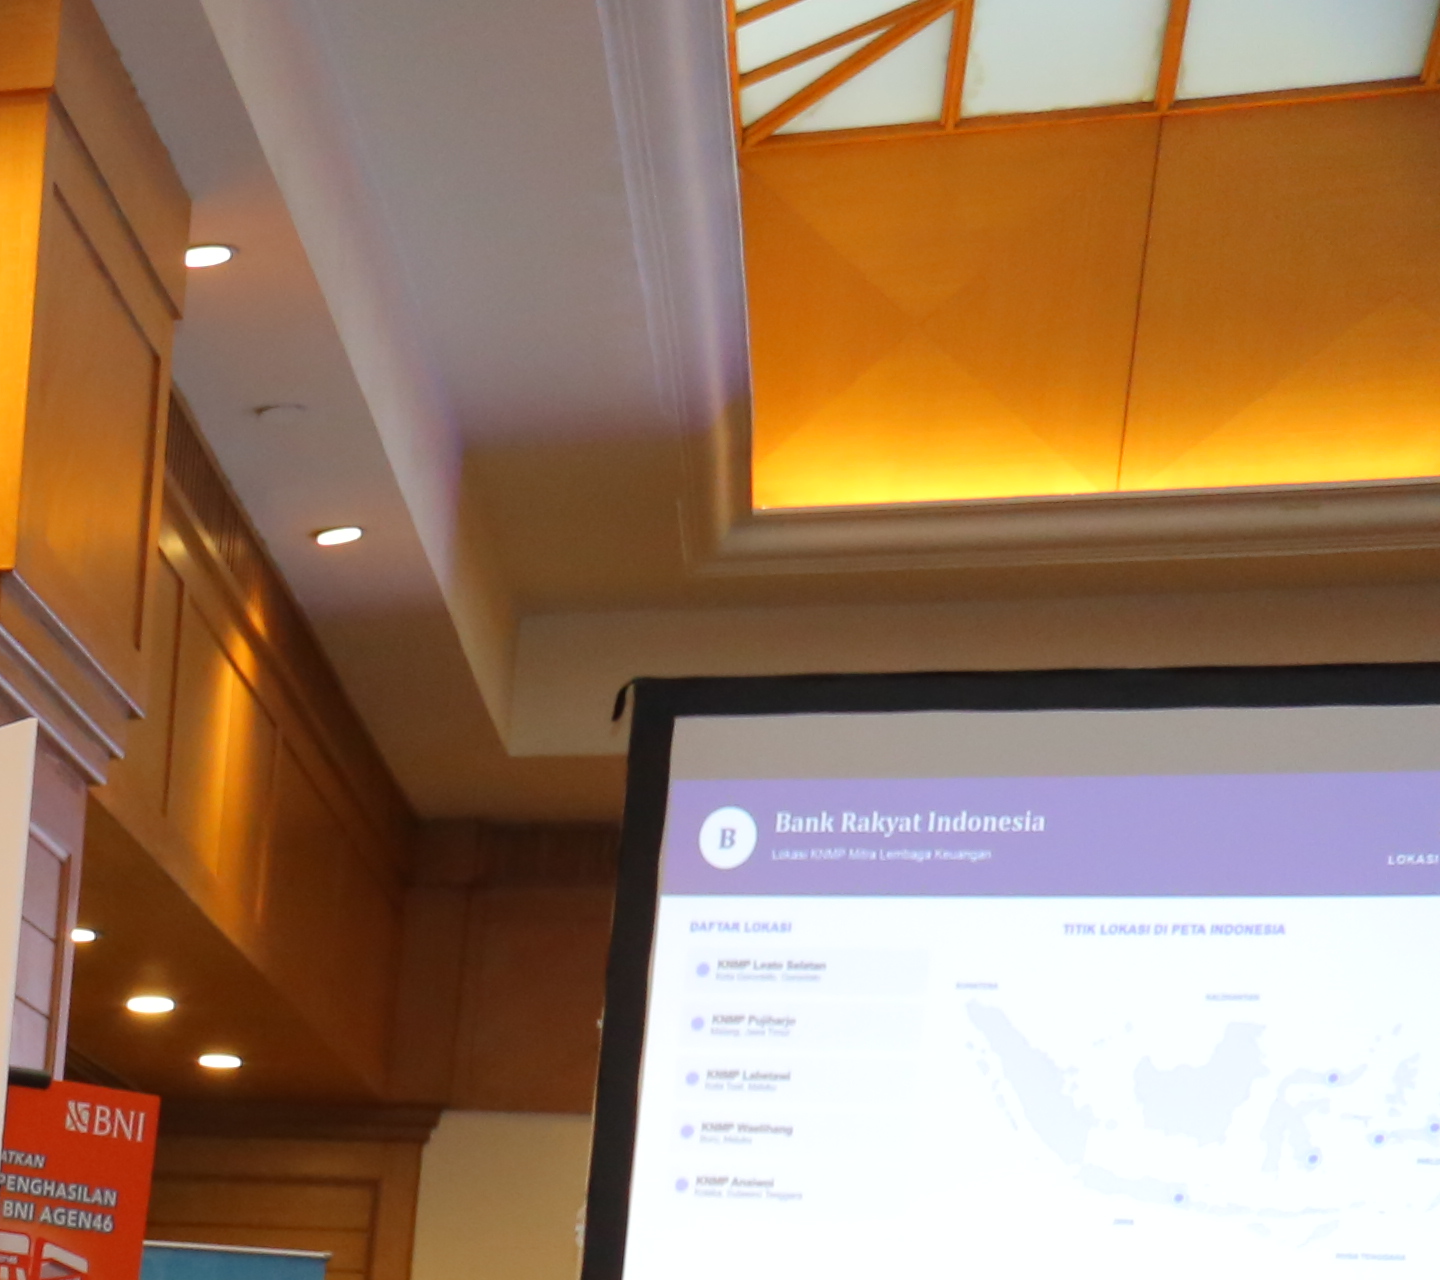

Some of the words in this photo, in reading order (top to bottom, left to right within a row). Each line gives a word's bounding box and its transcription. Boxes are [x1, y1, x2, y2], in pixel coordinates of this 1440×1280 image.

[775, 811, 835, 833] Bank
[841, 811, 922, 837] Rakyat
[928, 810, 1046, 833] Indonesia
[718, 827, 737, 850] B
[1387, 854, 1440, 866] LOKASI
[690, 921, 740, 933] DAFTAR
[744, 921, 793, 933] LOKASI
[1063, 923, 1096, 936] TITIK
[1100, 923, 1150, 936] LOKASI
[1154, 923, 1168, 936] DI
[1171, 923, 1206, 936] PETA
[1210, 923, 1286, 936] INDONESIA
[93, 1105, 146, 1142] BNI
[0, 1172, 118, 1207] PENGHASILAN
[2, 1199, 35, 1221] BNI
[39, 1205, 115, 1233] AGEN46
